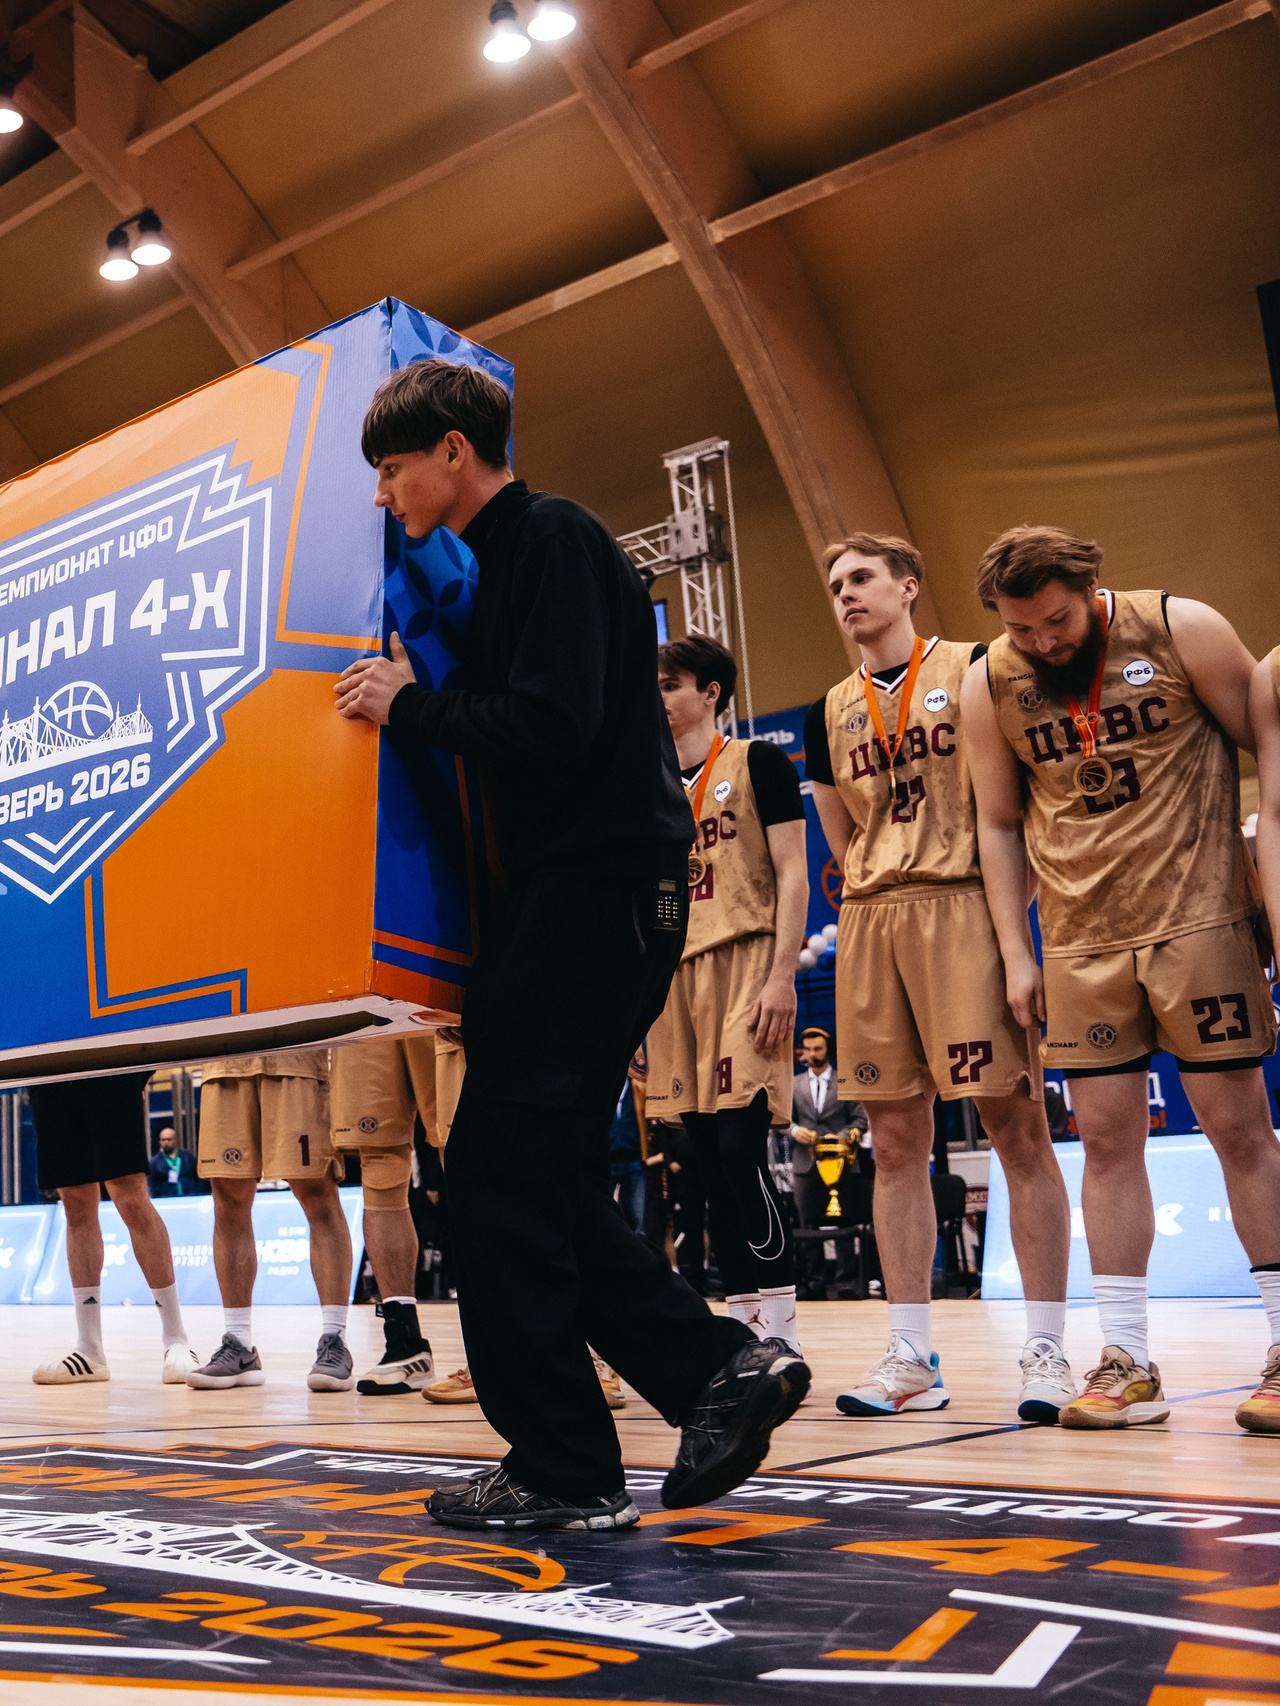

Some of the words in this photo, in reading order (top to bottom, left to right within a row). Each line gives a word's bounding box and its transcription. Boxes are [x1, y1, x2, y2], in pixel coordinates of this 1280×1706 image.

[118, 515, 173, 558] ЦФО
[129, 569, 232, 637] 4-Х
[1008, 673, 1036, 683] FANSH
[1126, 667, 1151, 678] РФБ
[849, 722, 956, 782] ЦКВС
[69, 752, 150, 807] 2026
[888, 775, 927, 825] 27
[697, 810, 737, 852] ВС
[1191, 993, 1252, 1044] 23
[948, 1040, 993, 1085] 27
[298, 1135, 310, 1166] 1
[907, 1496, 1243, 1529] ЦФО
[90, 1591, 640, 1680] 2026
